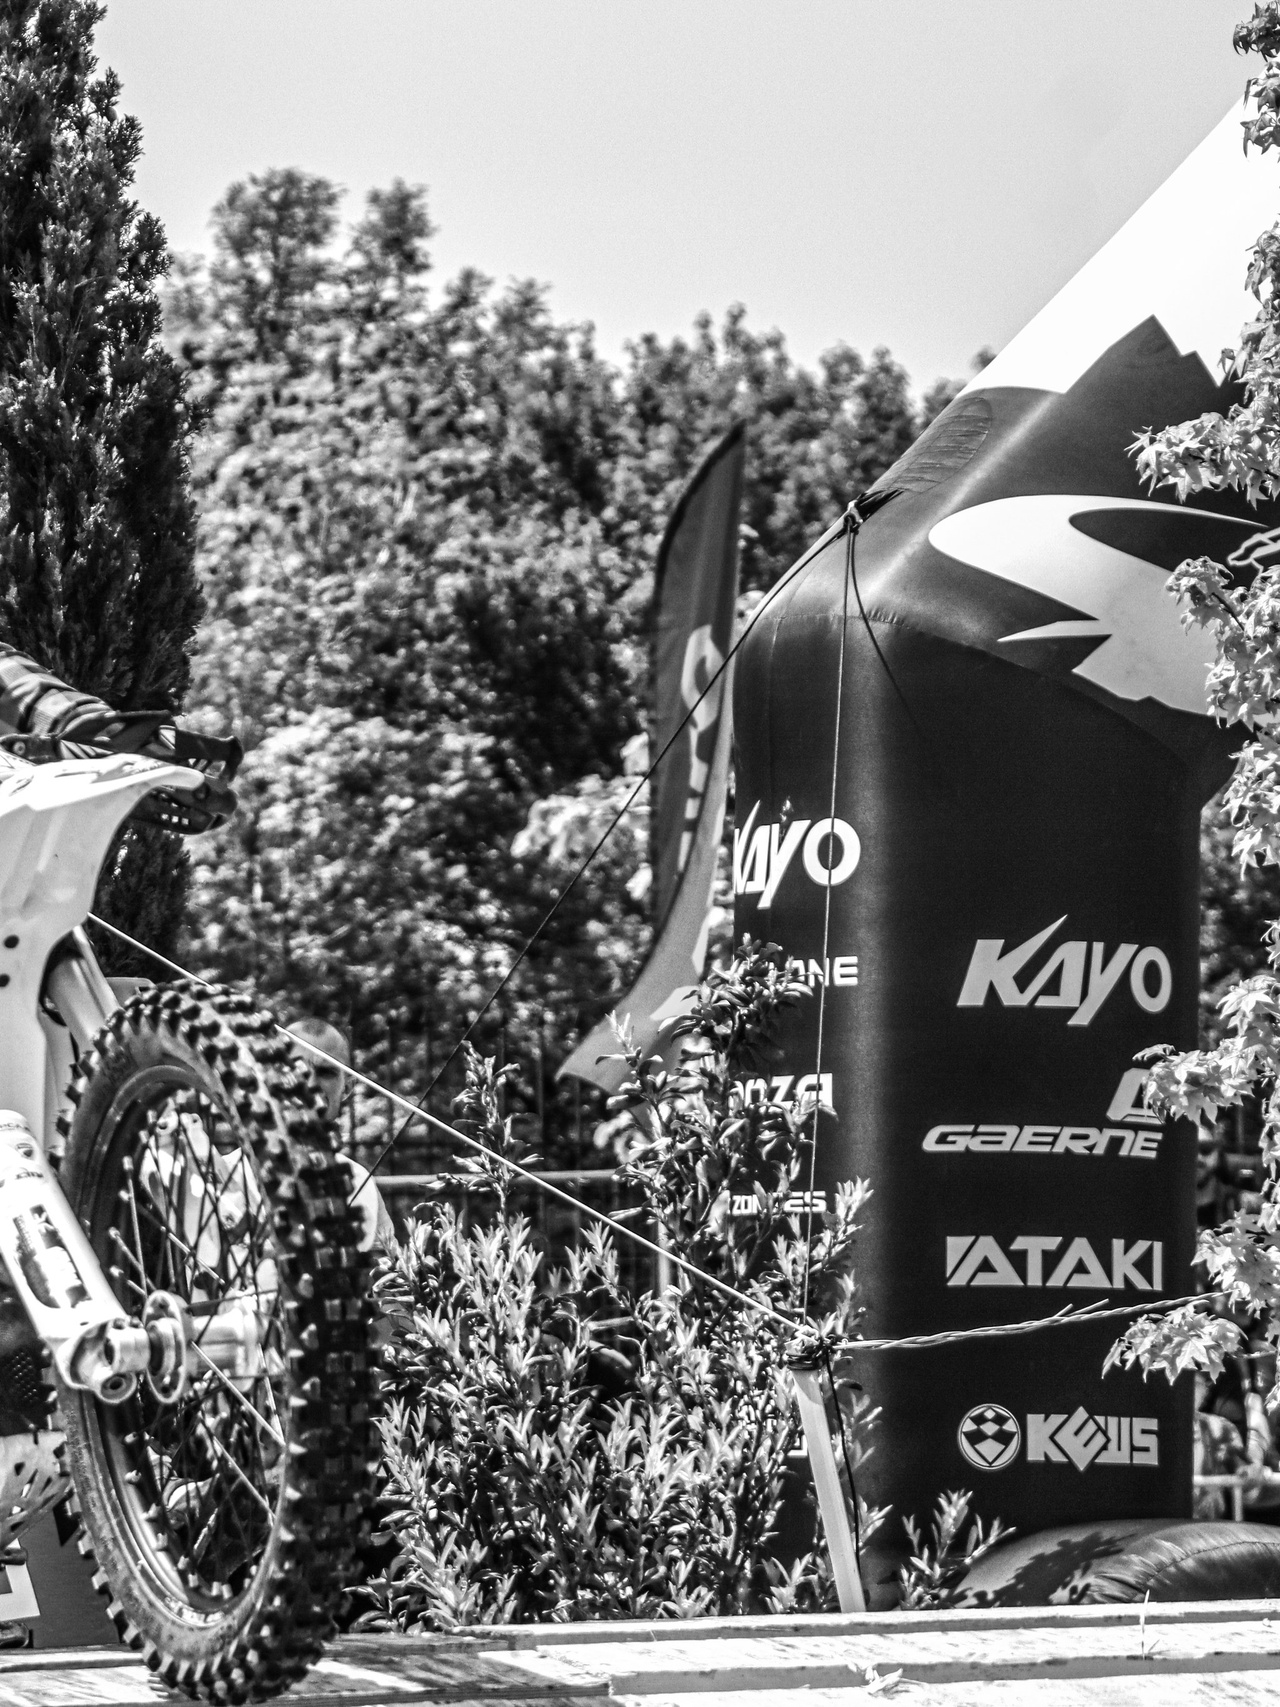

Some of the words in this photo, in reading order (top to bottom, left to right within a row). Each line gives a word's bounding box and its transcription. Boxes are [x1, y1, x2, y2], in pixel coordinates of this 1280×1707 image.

[956, 913, 1173, 1027] KAYO
[922, 1124, 1163, 1159] GAERNE
[946, 1235, 1163, 1292] ATAKI
